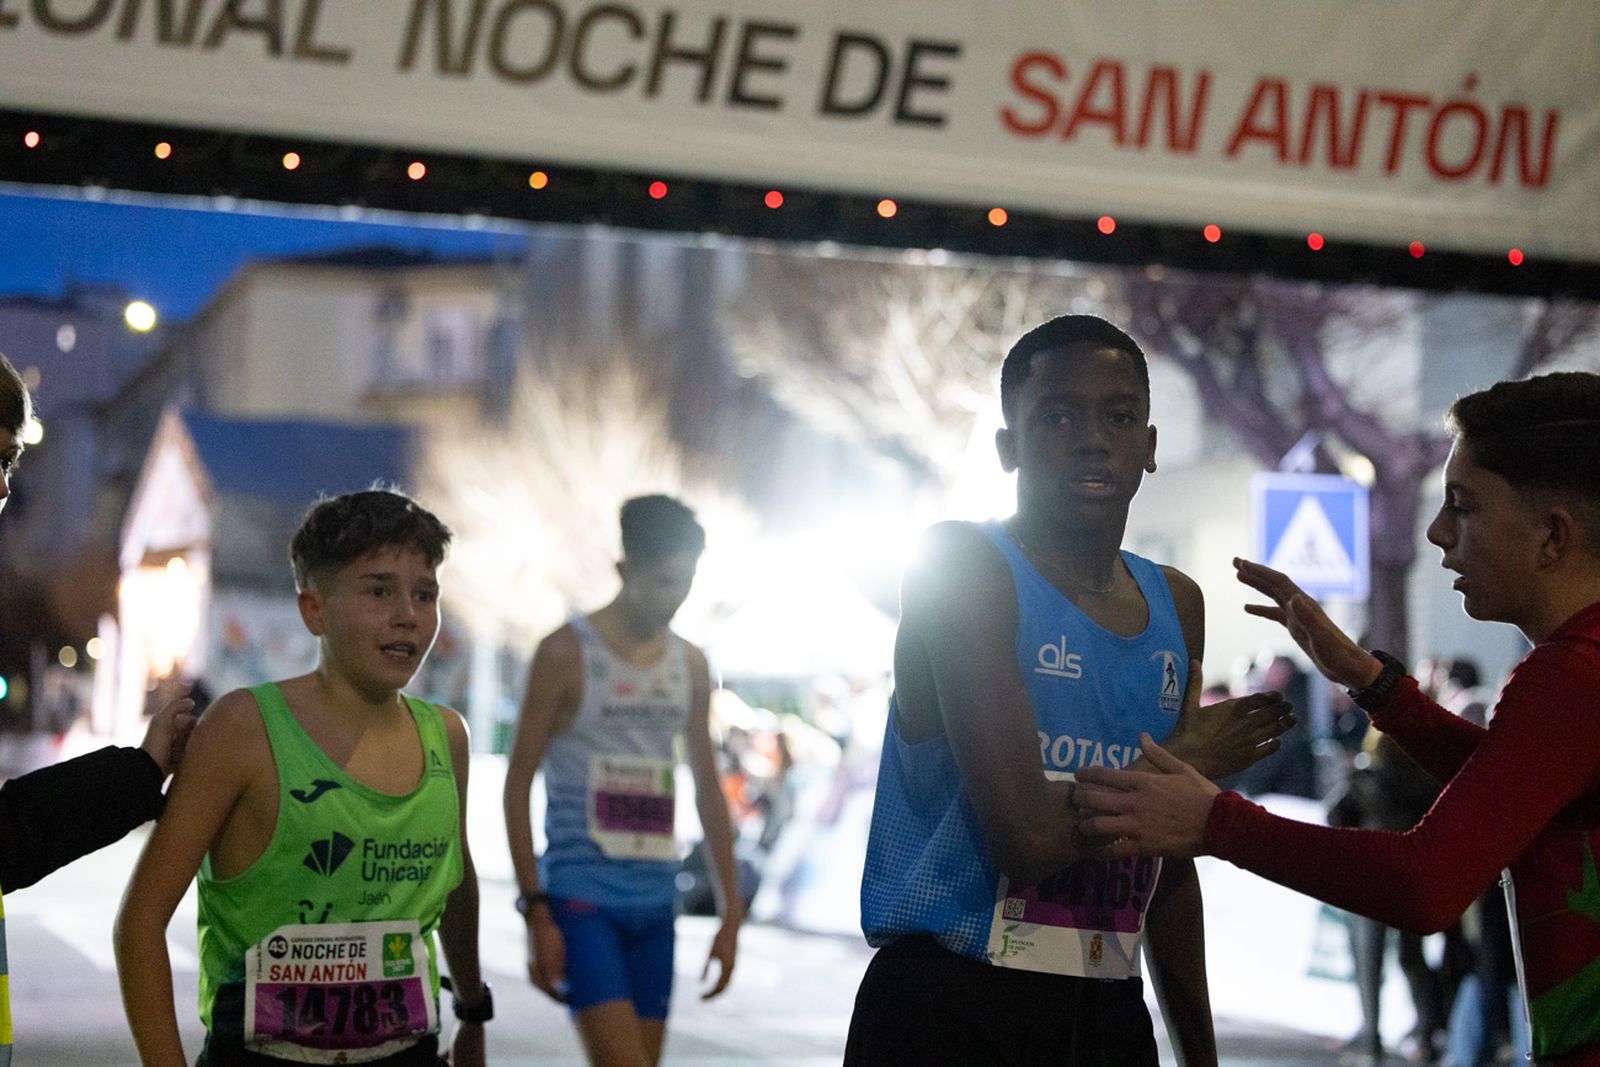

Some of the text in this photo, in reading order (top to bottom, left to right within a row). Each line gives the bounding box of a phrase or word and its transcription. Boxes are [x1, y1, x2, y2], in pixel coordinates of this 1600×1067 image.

[397, 0, 804, 110] NOCHE
[819, 30, 962, 128] DE
[999, 49, 1213, 155] SAN
[1226, 74, 1560, 190] ANTÓN
[1034, 635, 1082, 680] als
[269, 964, 305, 981] SAN
[309, 959, 367, 981] ANTÓN
[291, 942, 366, 959] NOCHE DE
[275, 983, 409, 1037] 14783
